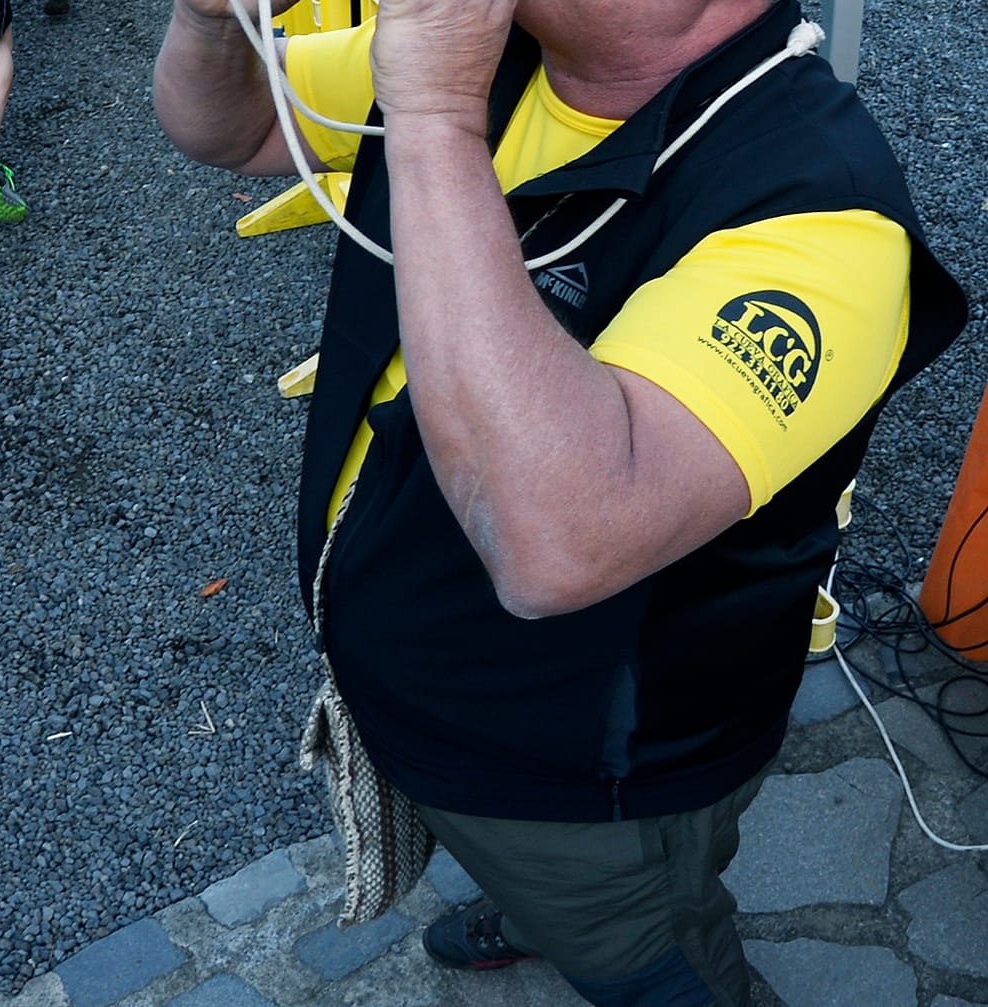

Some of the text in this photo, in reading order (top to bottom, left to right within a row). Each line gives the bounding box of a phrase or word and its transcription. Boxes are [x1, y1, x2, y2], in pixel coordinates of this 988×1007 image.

[720, 333, 746, 359] 922
[746, 356, 763, 375] 33
[763, 374, 778, 393] 11
